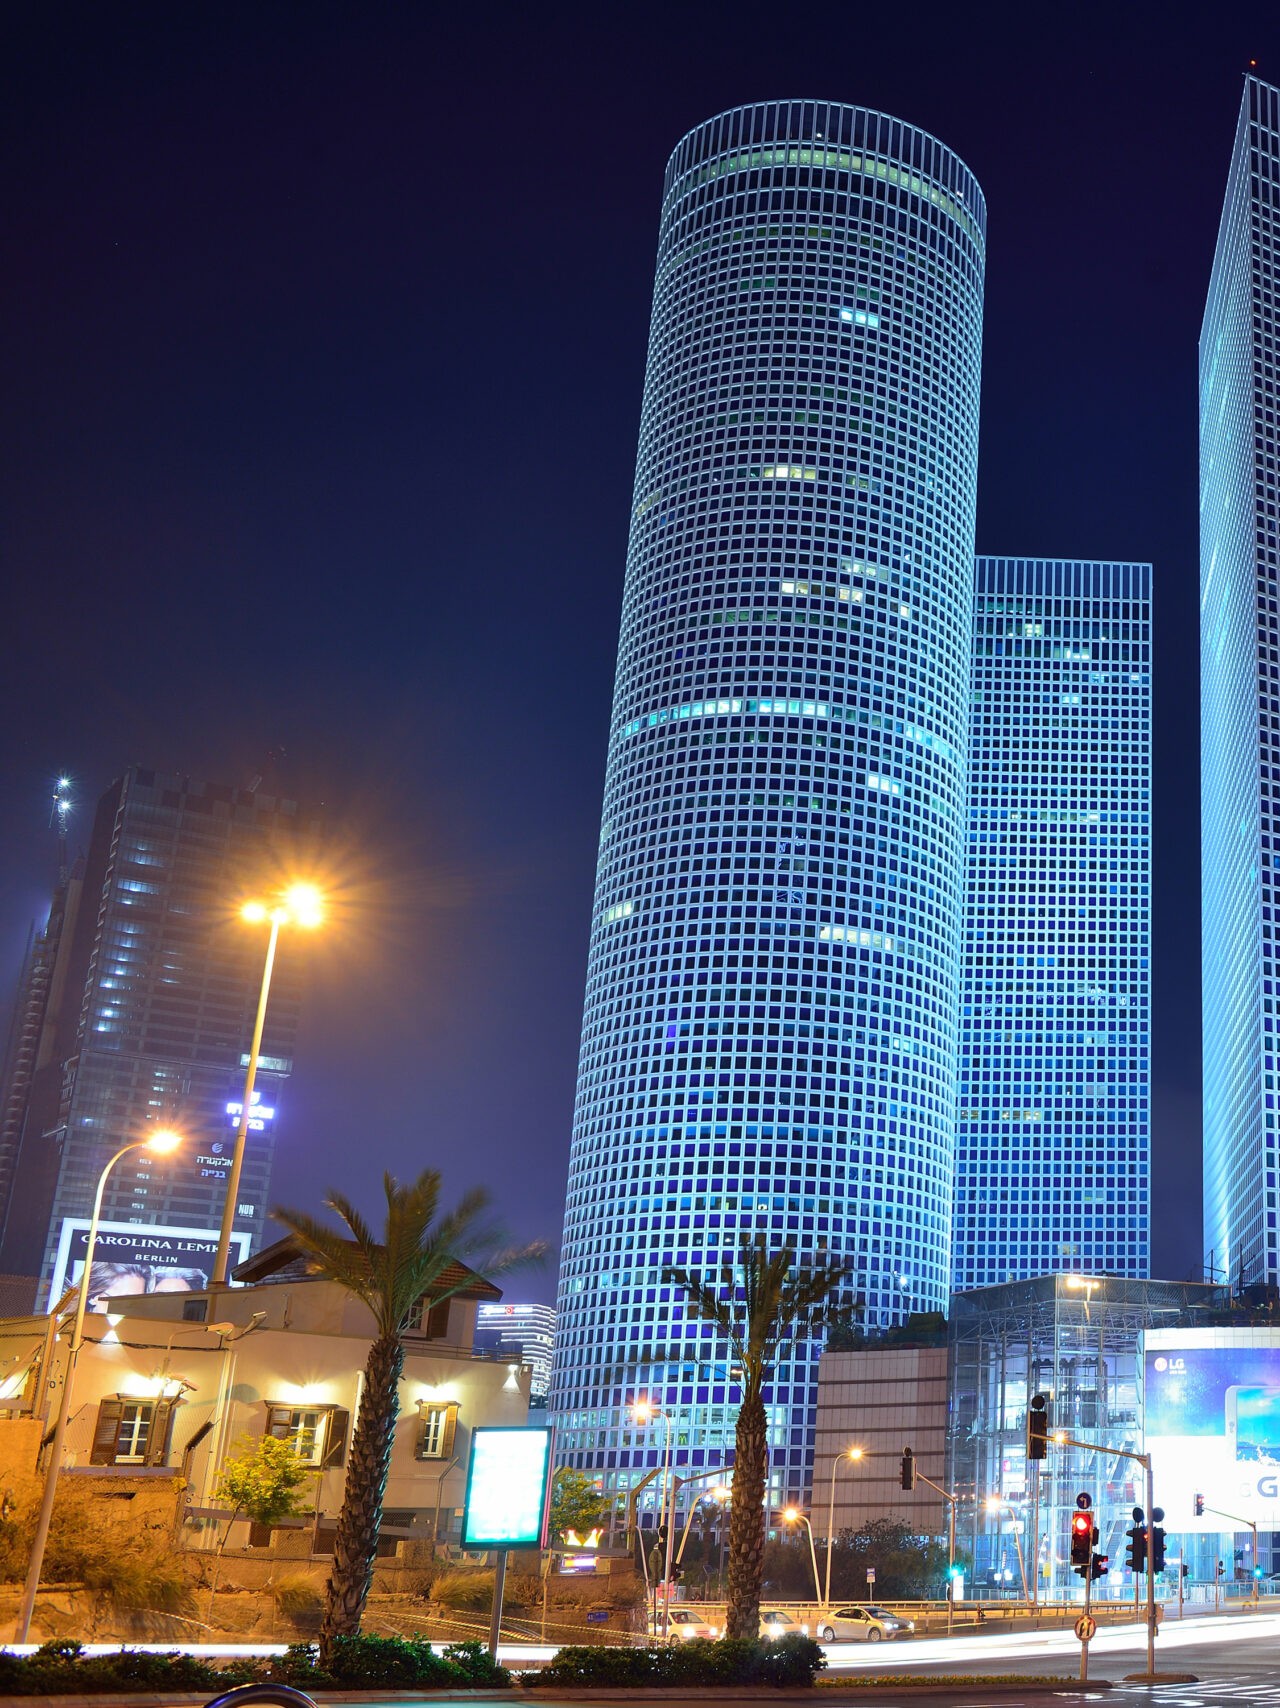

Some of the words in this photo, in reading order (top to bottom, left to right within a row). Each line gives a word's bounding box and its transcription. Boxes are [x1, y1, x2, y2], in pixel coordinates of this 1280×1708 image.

[196, 1155, 234, 1167] אלקטרה
[201, 1168, 226, 1178] בנייה
[81, 1234, 172, 1250] CAROLINA
[135, 1253, 178, 1263] BERLIN
[1169, 1358, 1185, 1370] LG
